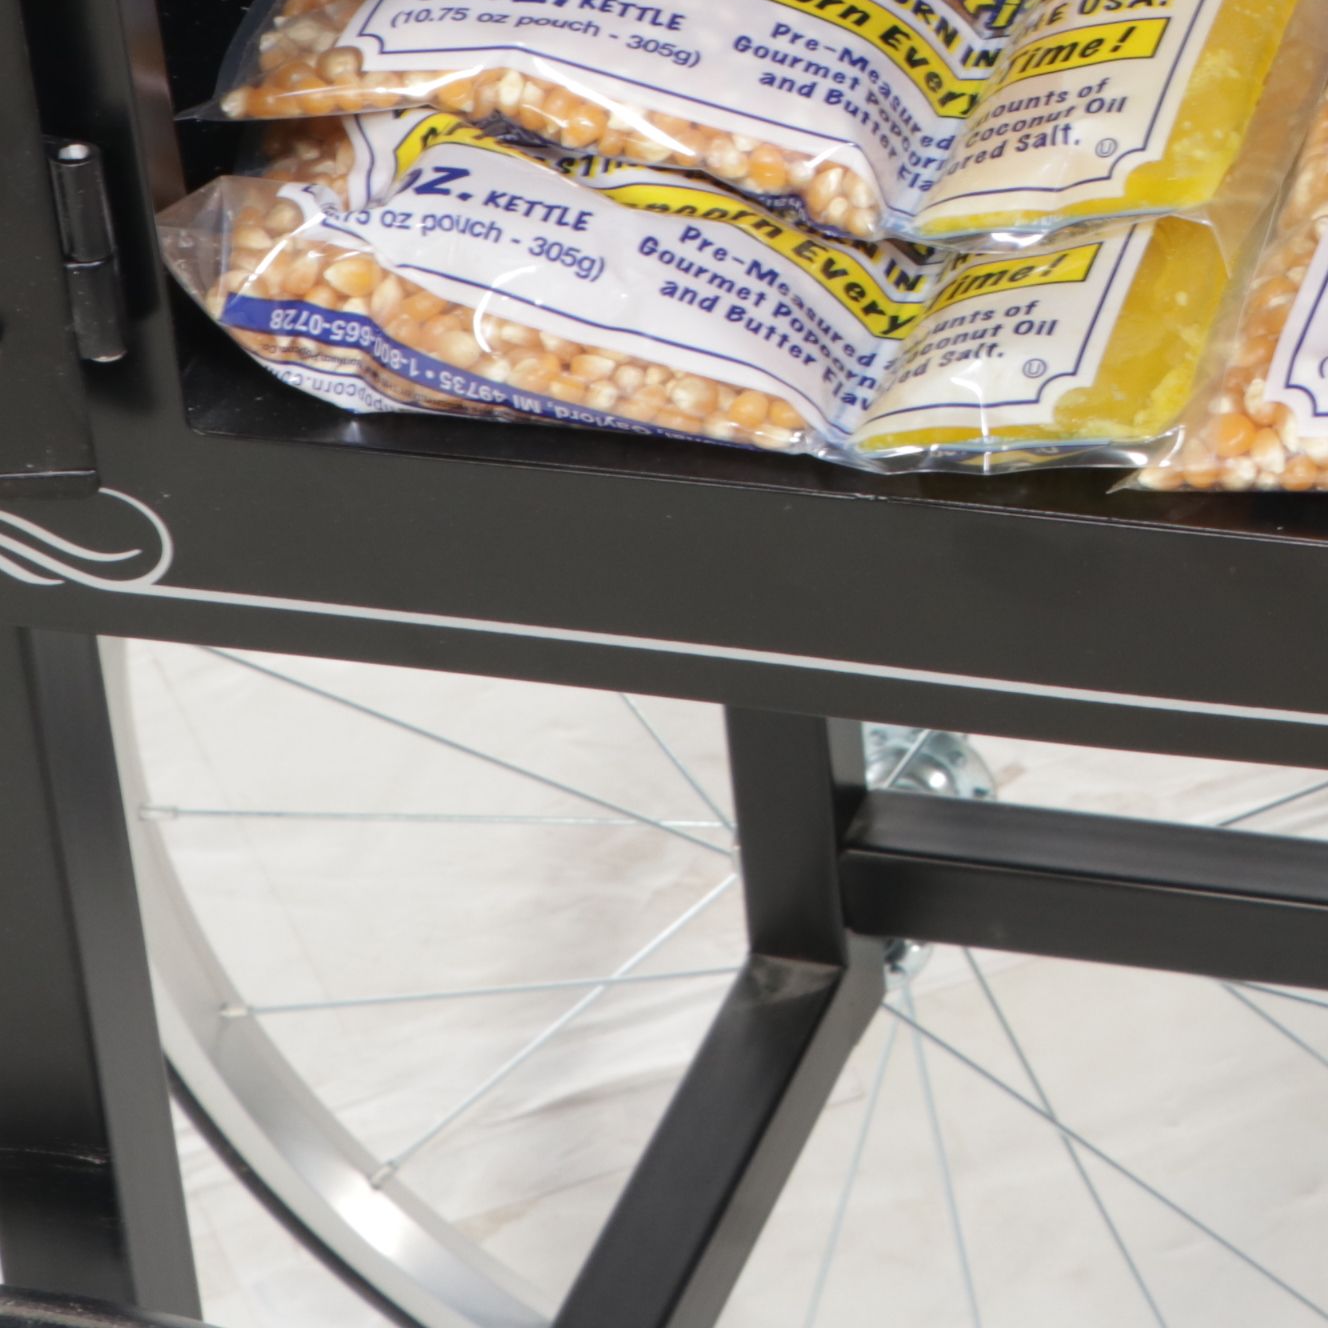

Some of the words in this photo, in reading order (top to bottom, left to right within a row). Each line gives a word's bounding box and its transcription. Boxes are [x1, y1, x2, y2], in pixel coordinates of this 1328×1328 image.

[389, 6, 471, 30] (10.75
[477, 12, 509, 25] oz
[515, 14, 601, 38] pouch
[625, 33, 702, 69] 305g)
[732, 34, 862, 93] Gourmet
[1083, 95, 1129, 115] Oil
[880, 24, 979, 116] Every
[960, 45, 1002, 72] IN
[759, 71, 819, 101] and
[823, 88, 900, 160] Butter
[1015, 123, 1082, 154] Salt.
[770, 21, 956, 152] Pre-Measured
[1077, 76, 1111, 99] of
[380, 210, 413, 230] oz
[421, 213, 505, 244] pouch
[528, 236, 605, 283] 305g)
[483, 189, 595, 233] KETTLE
[638, 235, 767, 308] Gourmet
[1013, 319, 1059, 337] Oil
[679, 225, 878, 369] Pre-Measured
[1004, 300, 1041, 318] of
[793, 238, 914, 337] Every
[884, 260, 925, 294] IN
[270, 308, 420, 378] 1-800-665-0728
[660, 278, 722, 314] and
[723, 304, 818, 367] Butter
[938, 343, 1005, 367] Salt.
[439, 371, 508, 405] 49735
